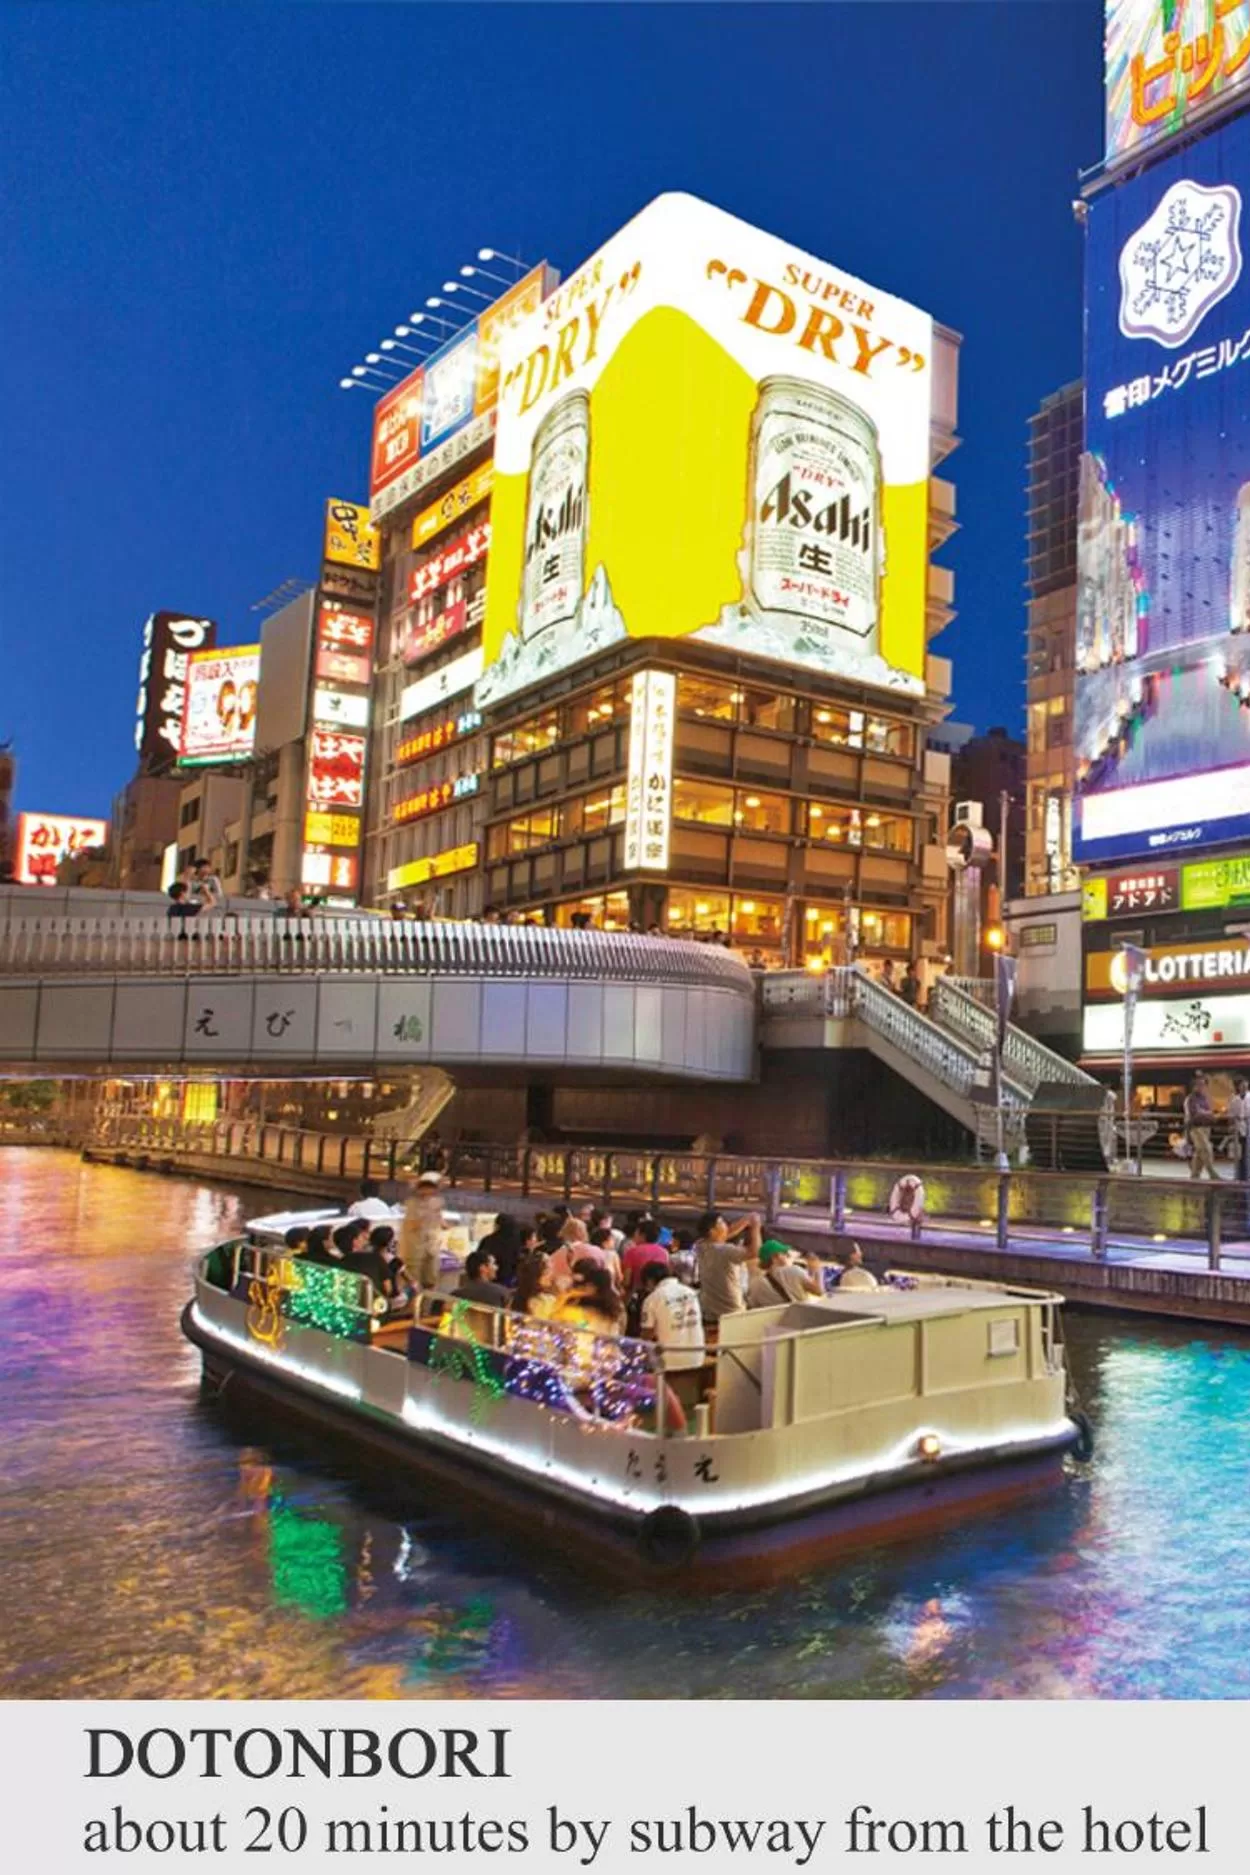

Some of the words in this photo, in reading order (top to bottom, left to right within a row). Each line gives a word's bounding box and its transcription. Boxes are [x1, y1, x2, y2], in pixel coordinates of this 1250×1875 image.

[782, 263, 876, 322] SUPER
[760, 470, 869, 553] Asahi
[799, 543, 833, 576] 生
